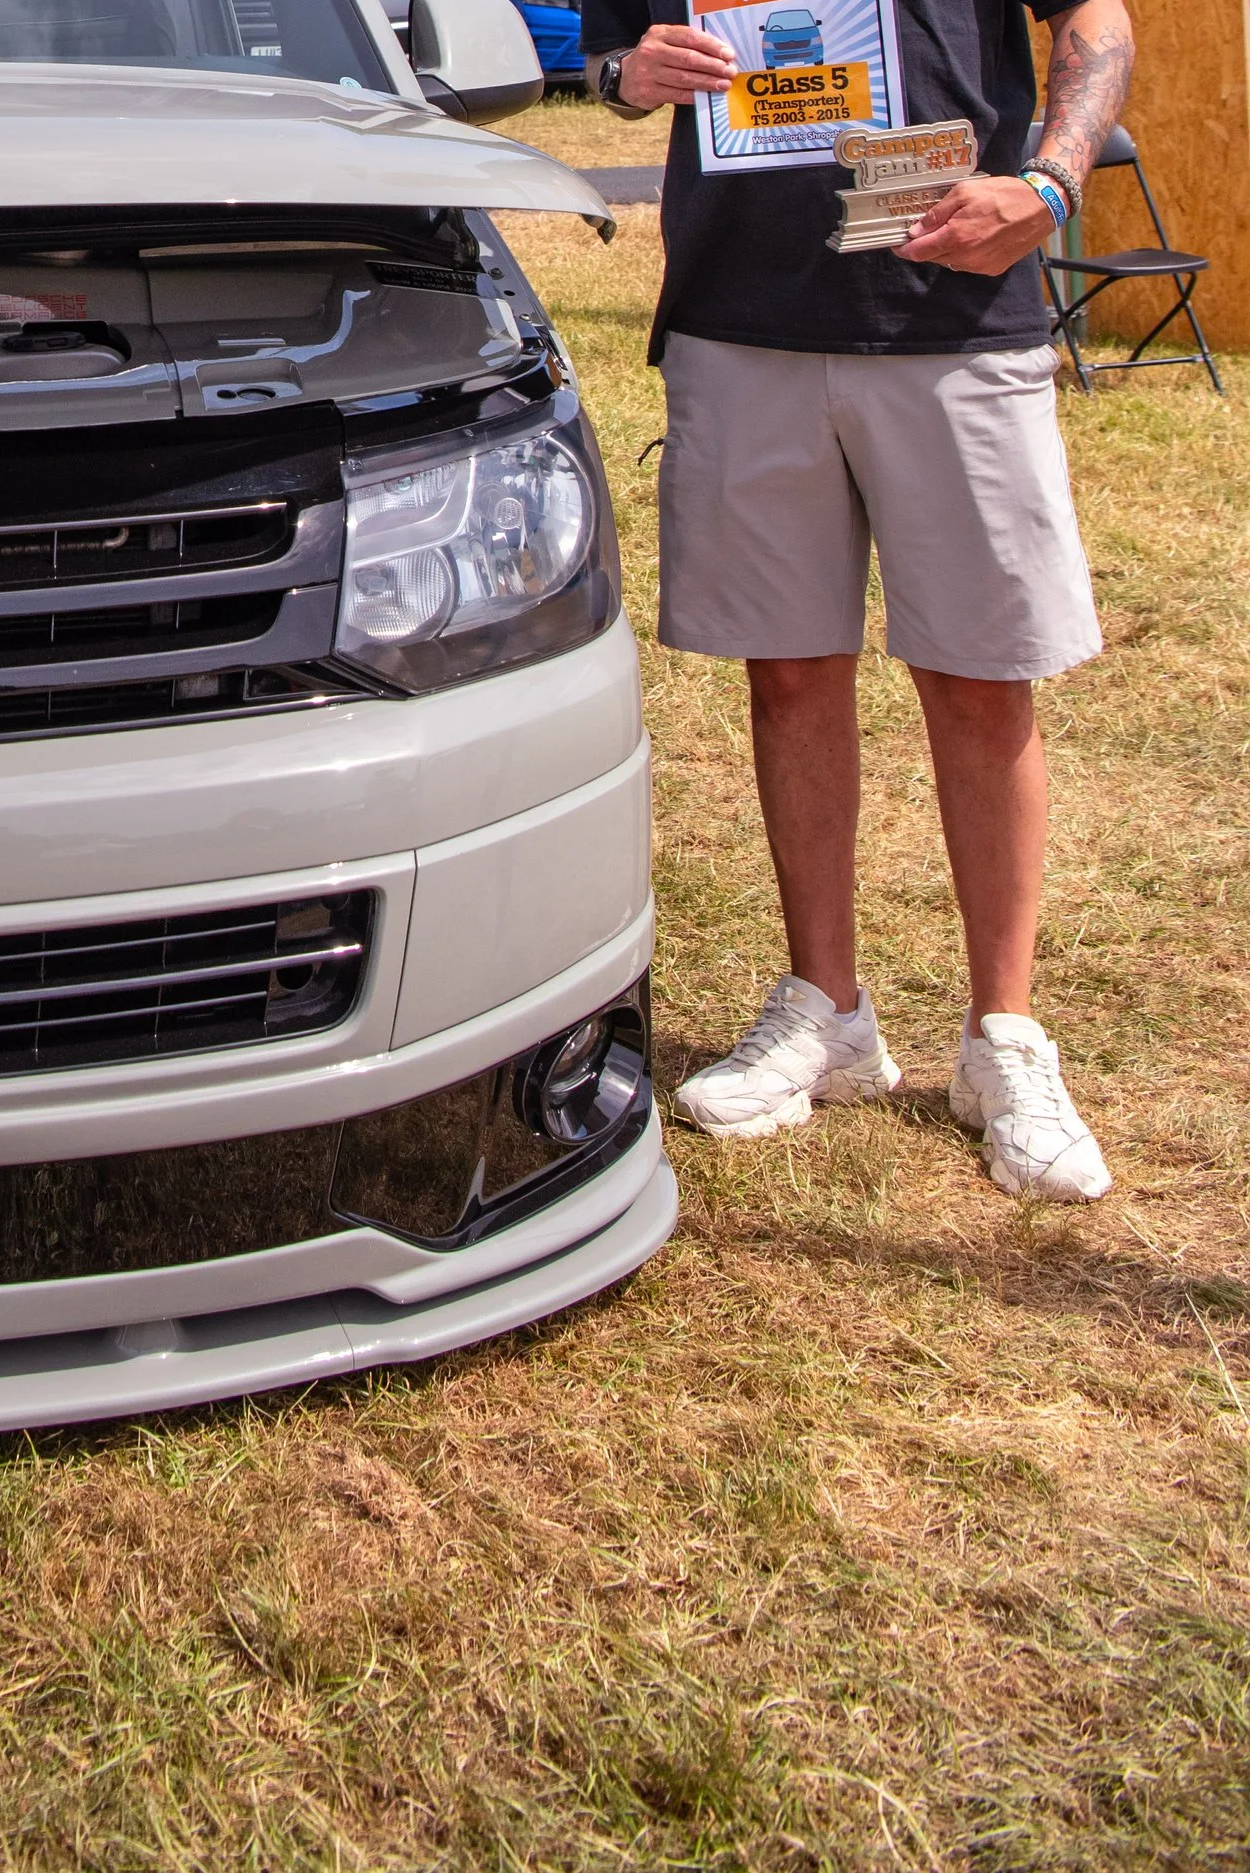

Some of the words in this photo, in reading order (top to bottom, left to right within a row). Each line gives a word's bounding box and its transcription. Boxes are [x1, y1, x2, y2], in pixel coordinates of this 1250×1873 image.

[746, 73, 825, 97] Class
[831, 67, 849, 90] 5
[754, 94, 845, 113] (Transporter)
[751, 114, 769, 126] T5
[772, 112, 806, 125] 2003
[816, 108, 851, 121] 2015
[752, 136, 783, 144] Weston
[807, 129, 844, 140] Shropsh
[845, 130, 966, 159] Camper
[876, 193, 918, 206] CLASS
[888, 202, 938, 216] WINN
